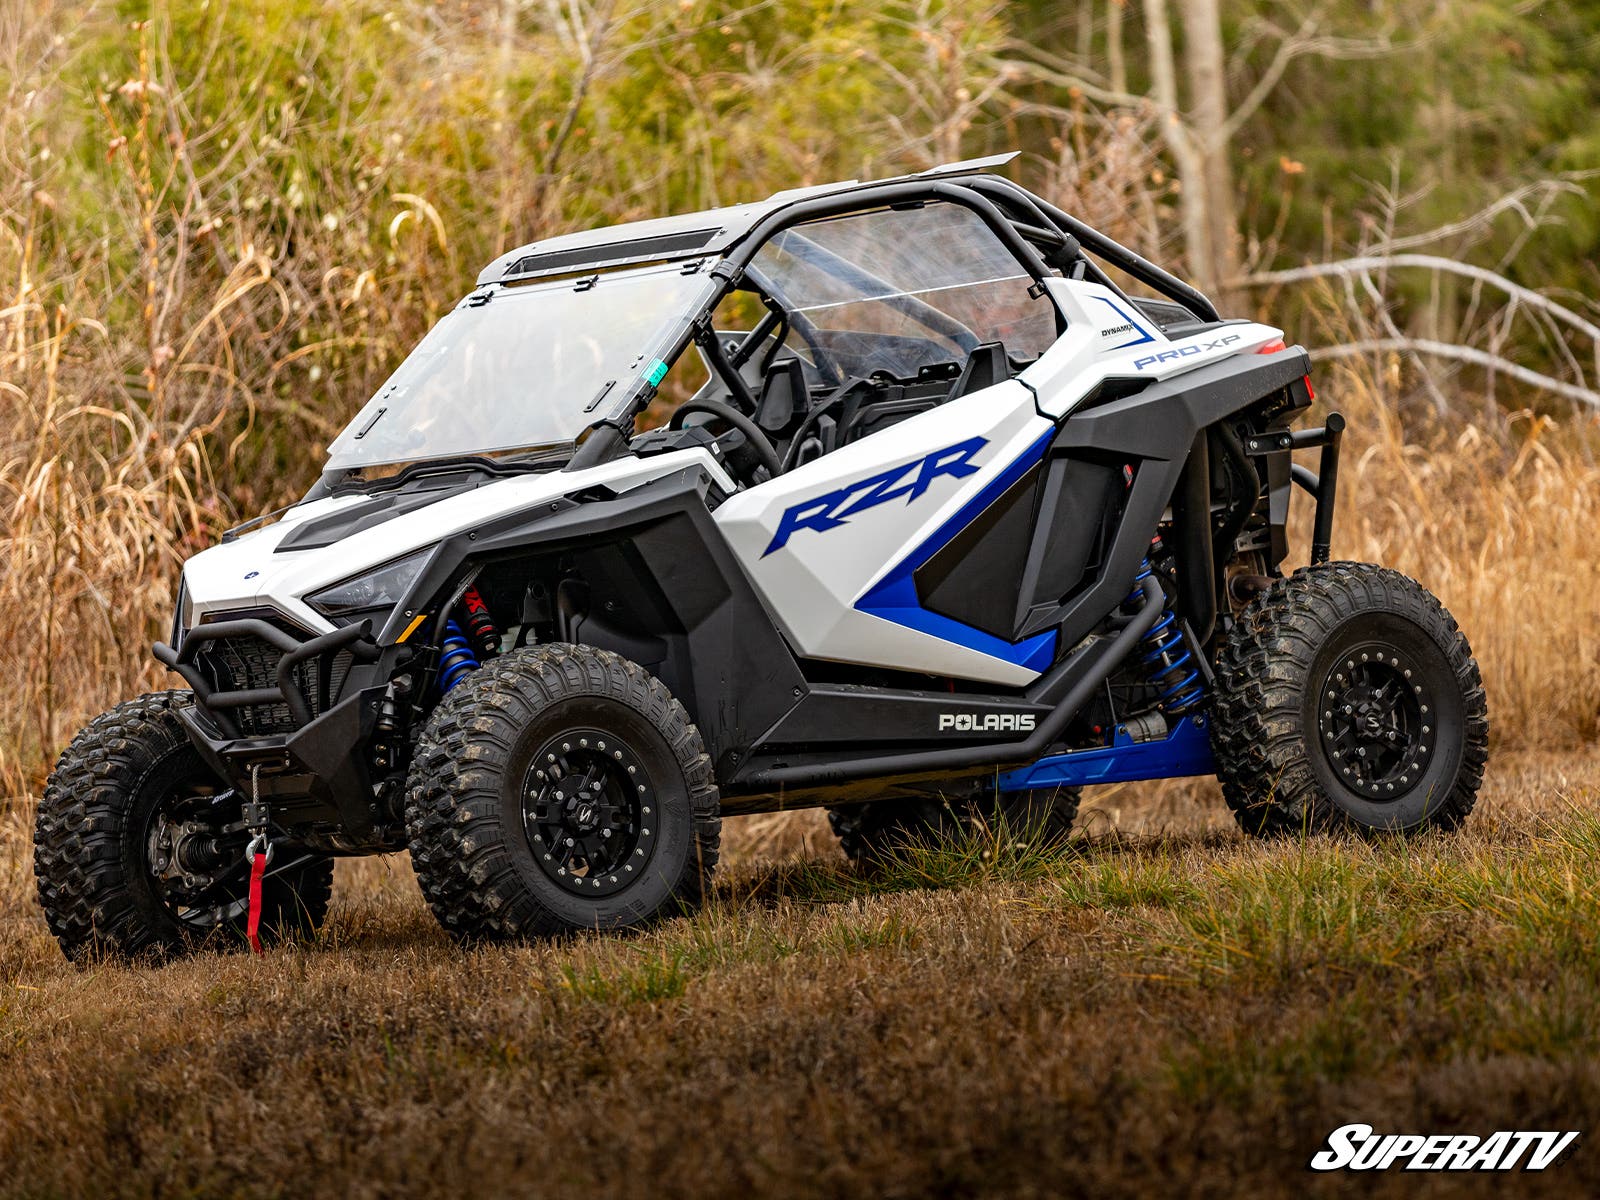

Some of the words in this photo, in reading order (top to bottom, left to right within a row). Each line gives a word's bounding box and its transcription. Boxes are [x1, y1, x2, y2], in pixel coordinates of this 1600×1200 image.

[1134, 345, 1202, 371] PRO
[1201, 334, 1241, 351] XP
[759, 435, 991, 560] RZR
[939, 714, 1036, 731] POLARIS
